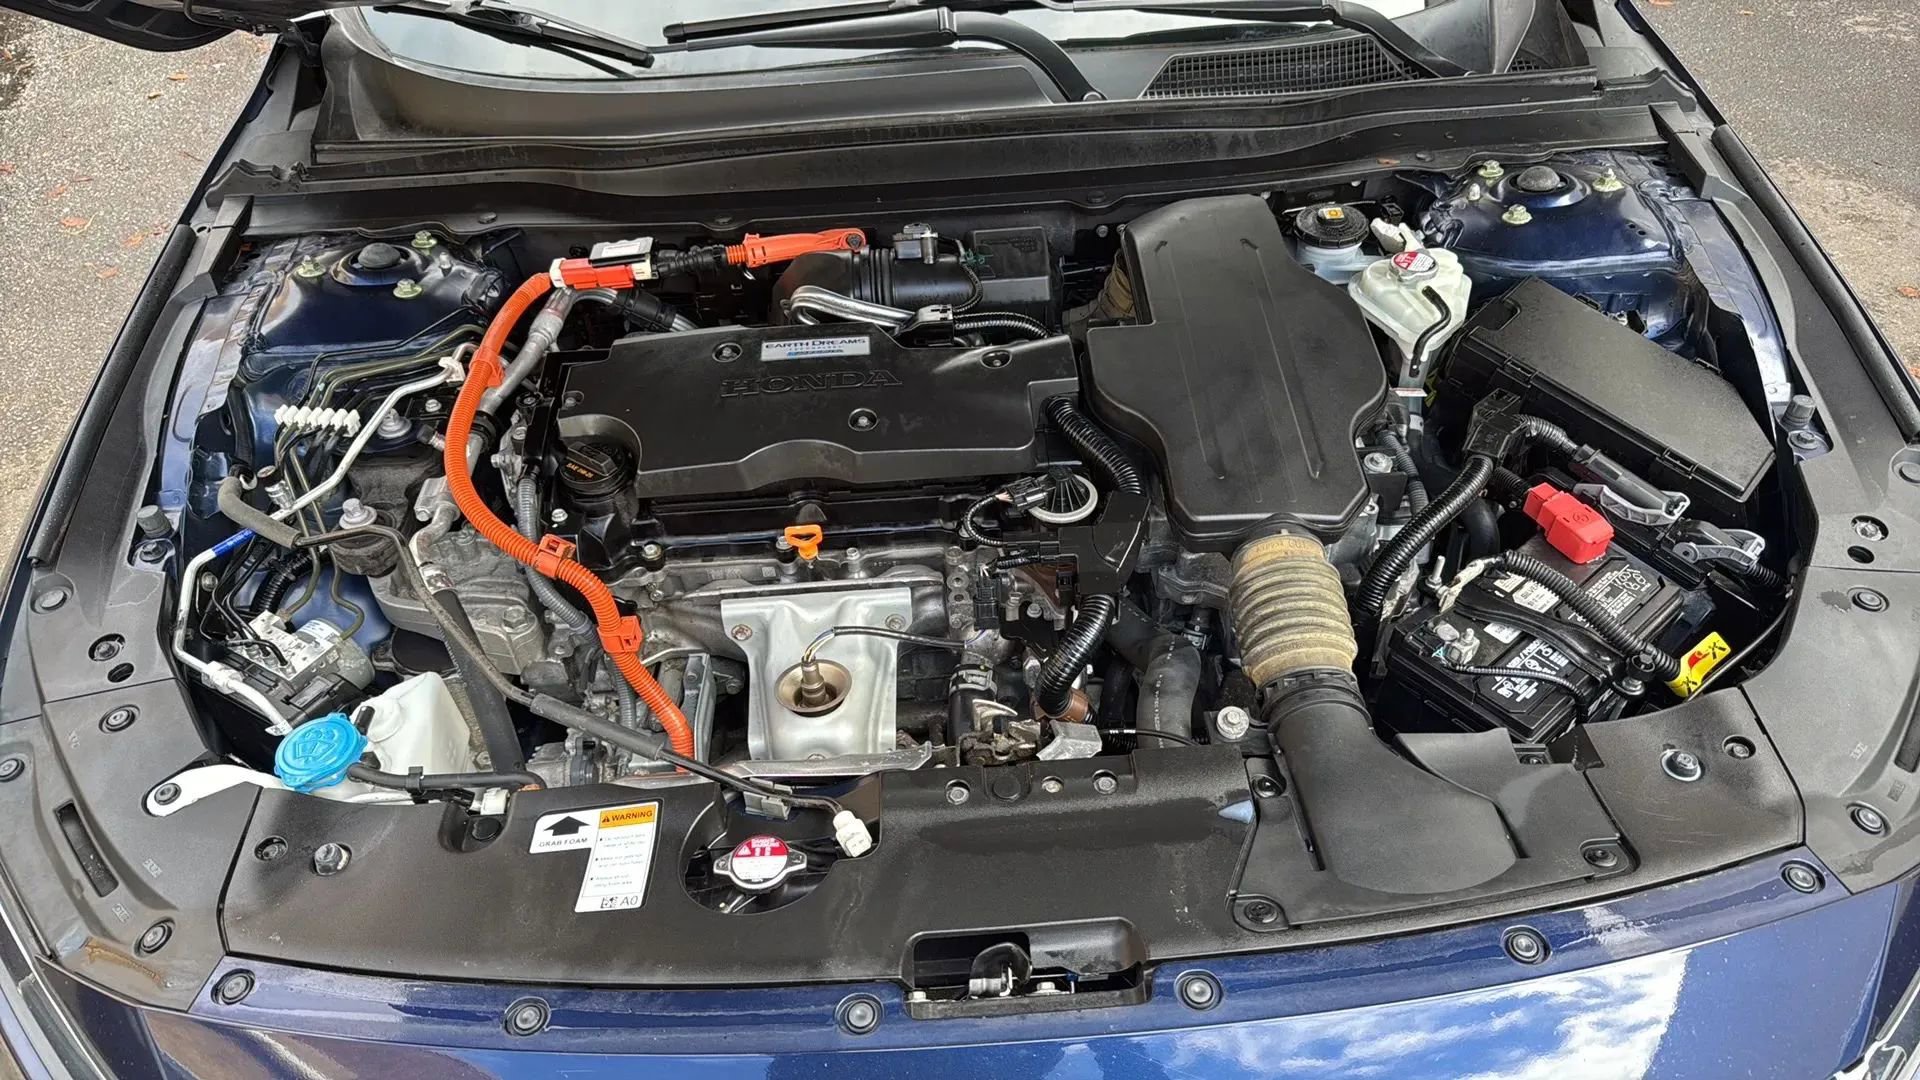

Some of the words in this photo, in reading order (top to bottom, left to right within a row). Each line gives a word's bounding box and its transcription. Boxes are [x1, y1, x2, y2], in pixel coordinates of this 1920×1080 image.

[765, 340, 809, 349] EARTH
[811, 338, 866, 347] DREAMS
[721, 370, 902, 397] HONDA
[611, 810, 653, 822] WARNING
[538, 839, 563, 848] GRAB
[563, 837, 588, 846] FOAM
